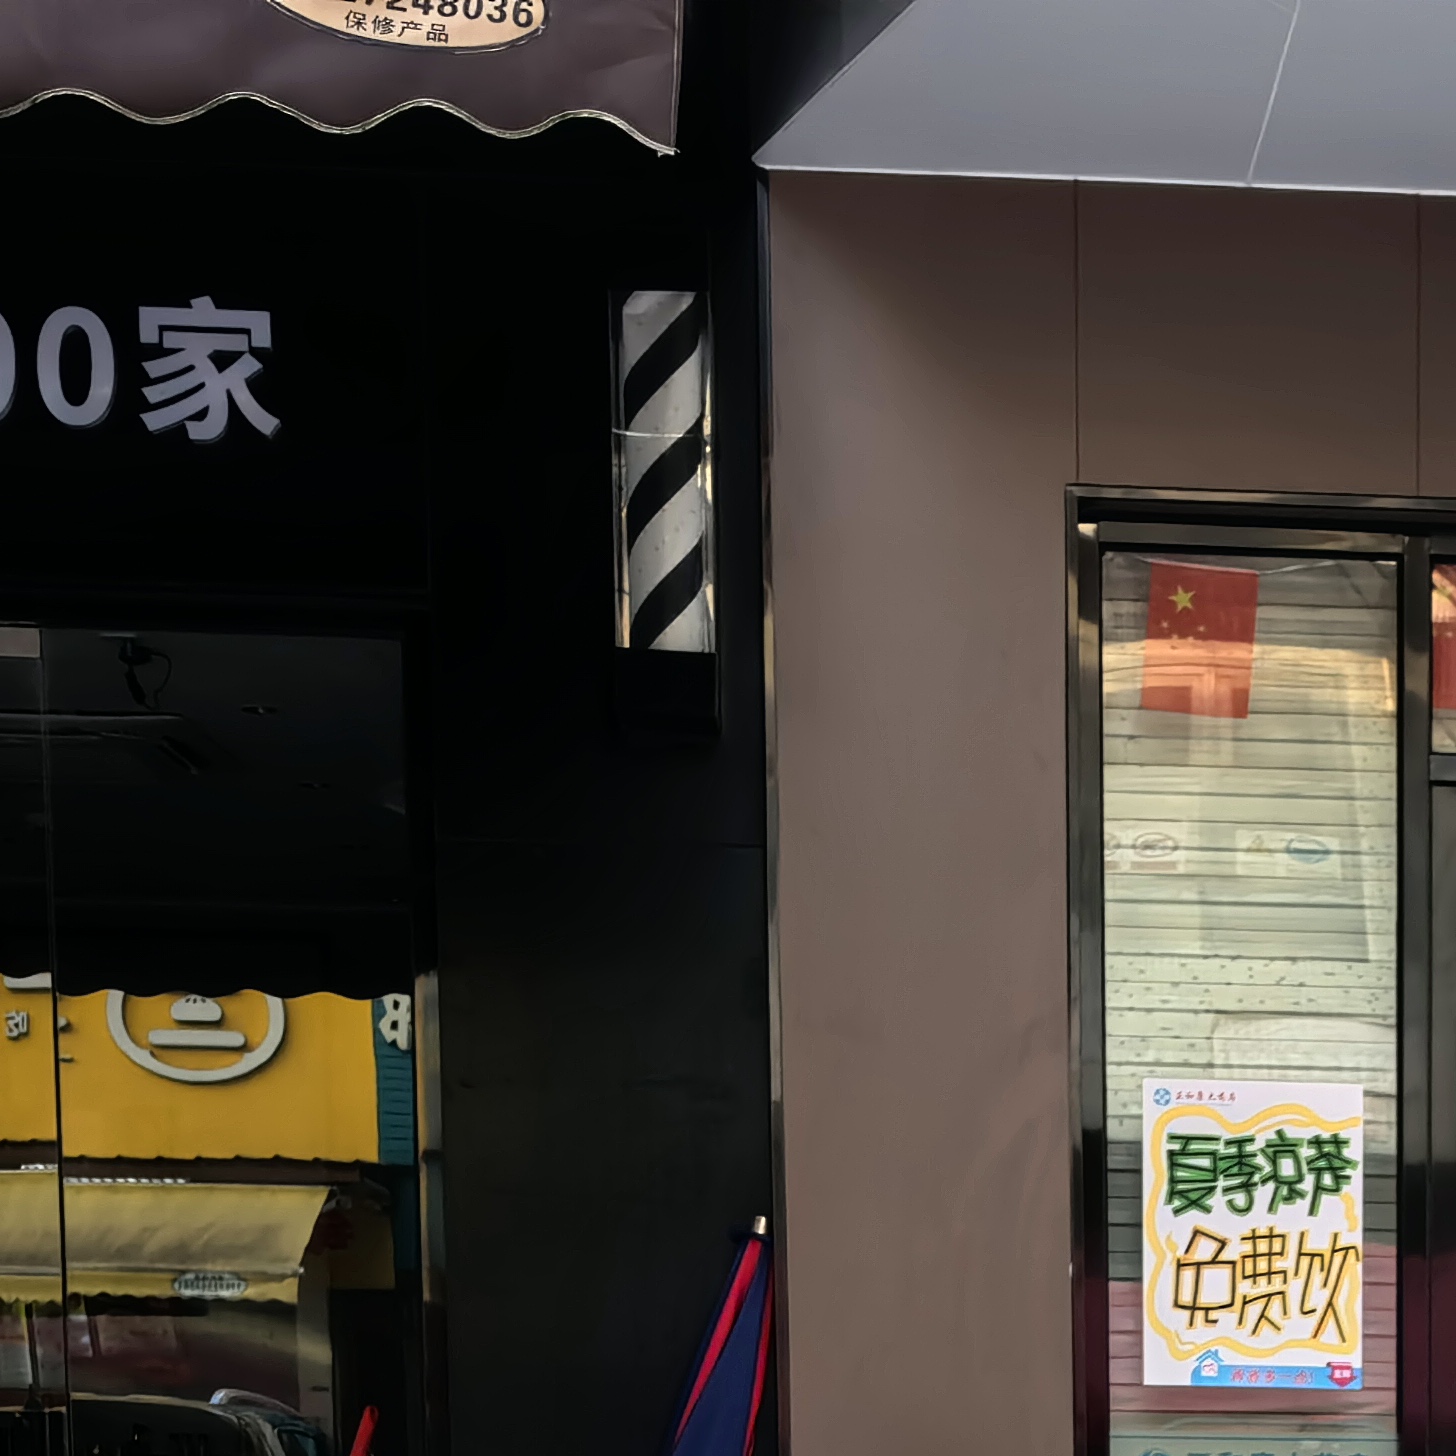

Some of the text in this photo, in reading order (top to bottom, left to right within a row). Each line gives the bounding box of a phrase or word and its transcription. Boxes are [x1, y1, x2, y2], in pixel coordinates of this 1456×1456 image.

[346, 10, 449, 43] 保修产品
[1164, 1128, 1359, 1218] 夏季凉茶
[1173, 1225, 1361, 1345] 免费饮
